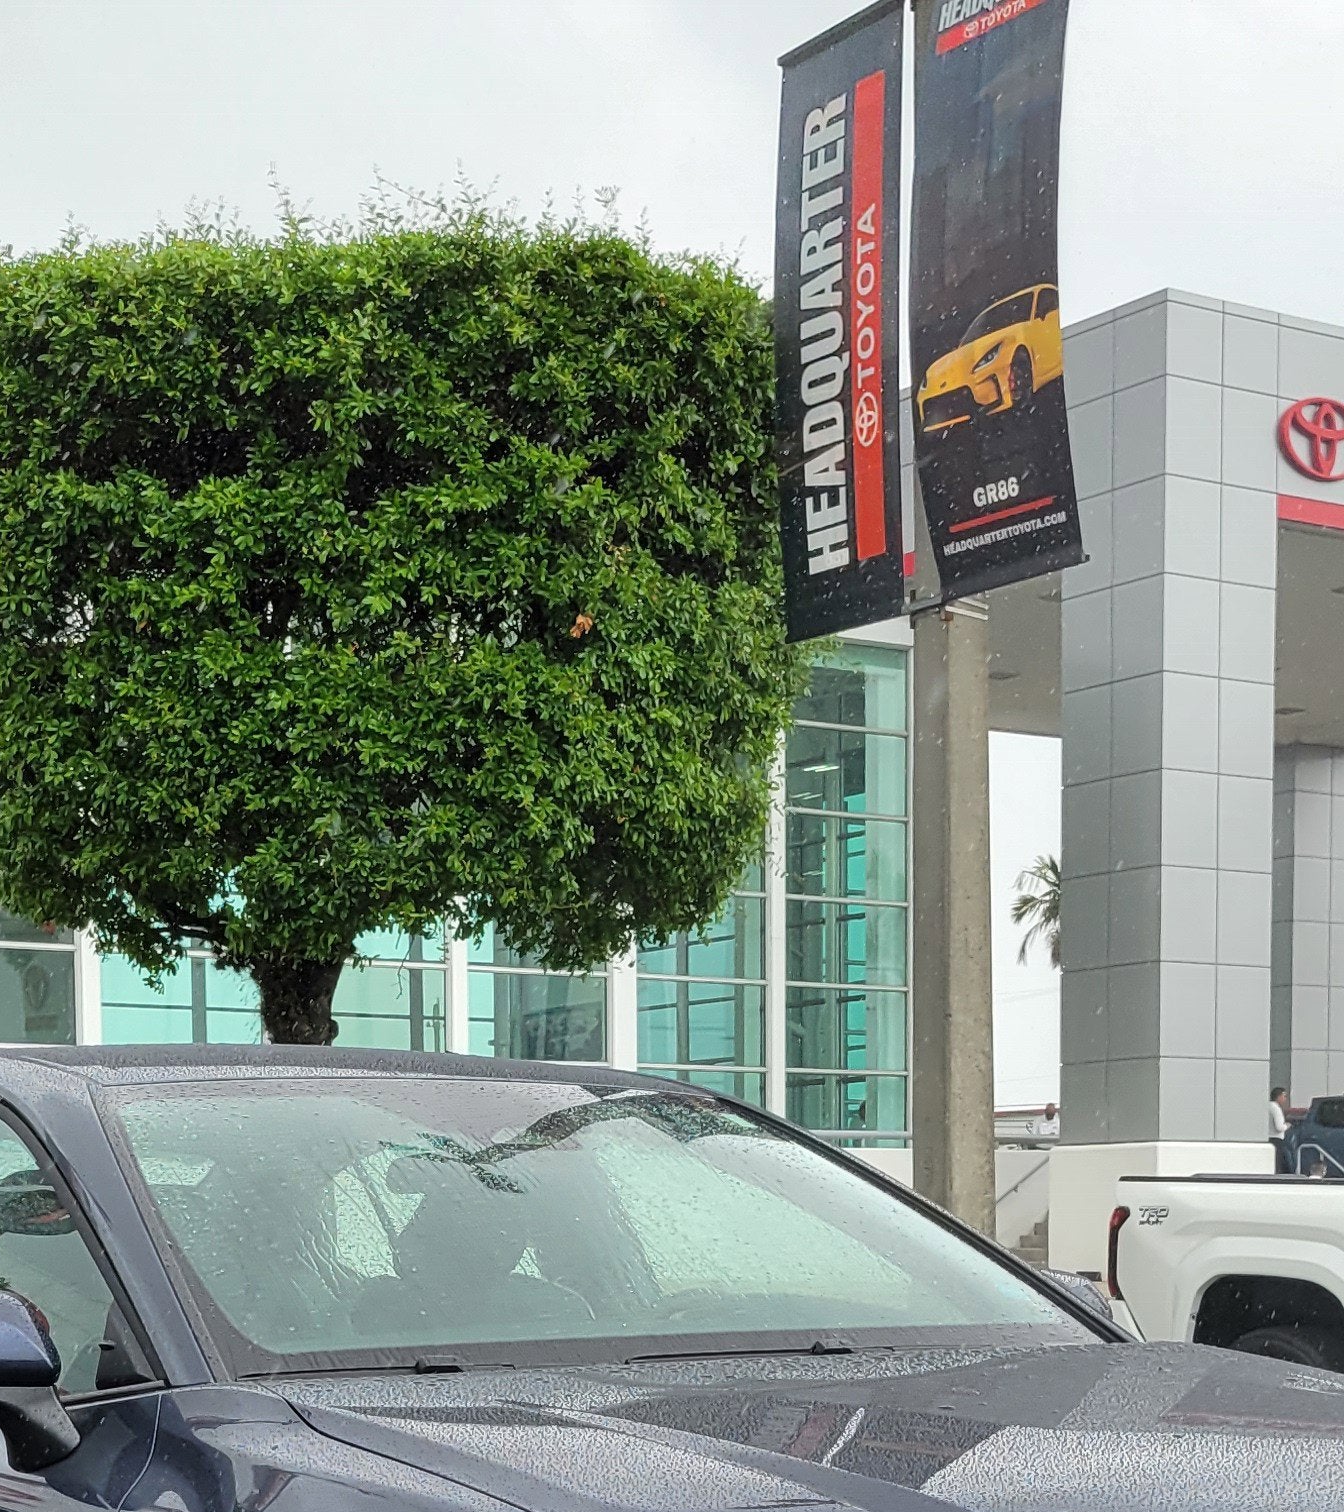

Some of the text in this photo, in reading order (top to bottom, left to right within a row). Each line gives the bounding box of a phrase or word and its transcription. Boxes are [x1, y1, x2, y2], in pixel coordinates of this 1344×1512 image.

[979, 0, 1027, 29] TOYOTA
[857, 203, 876, 389] TOYOTA
[799, 92, 850, 576] HEADQUARTER
[973, 476, 1020, 508] GR86
[942, 511, 1068, 557] HEADQUARTERTOYOTA.COM
[1139, 1205, 1170, 1220] TRD
